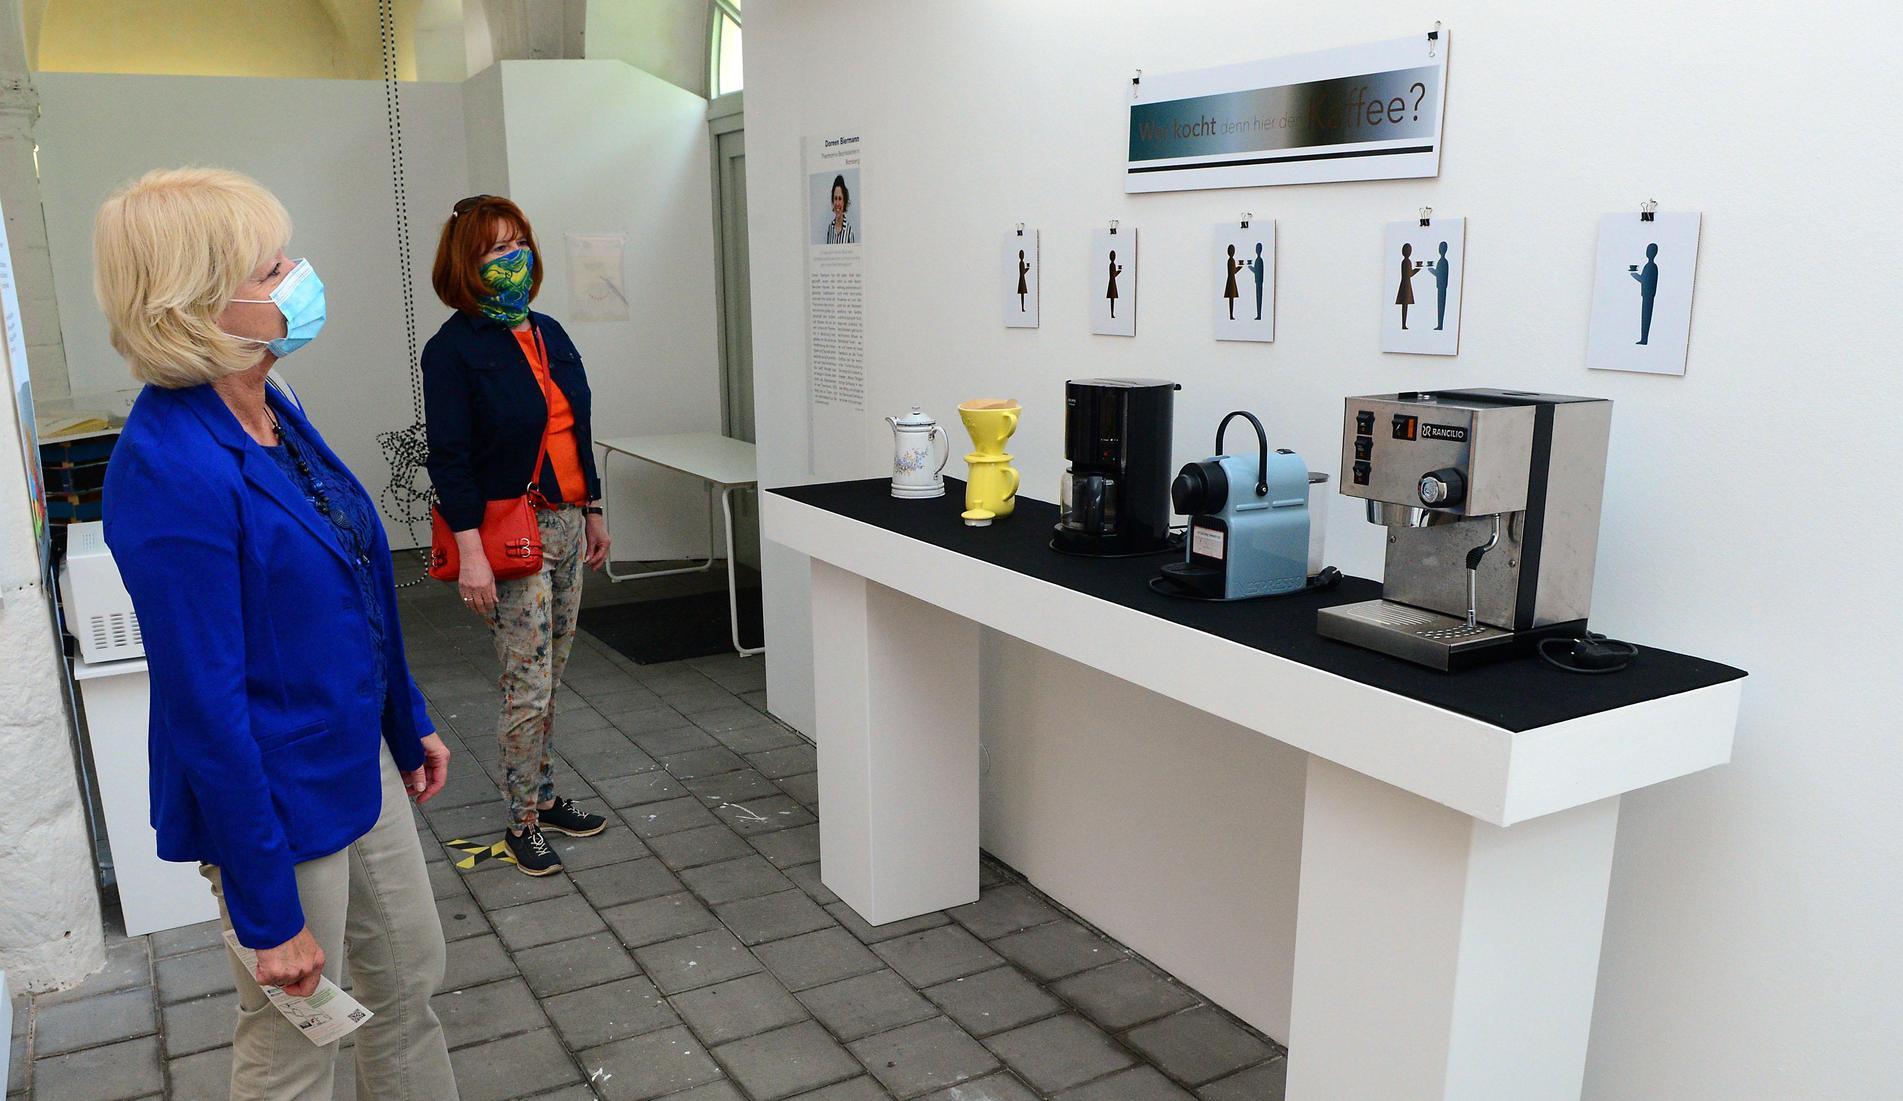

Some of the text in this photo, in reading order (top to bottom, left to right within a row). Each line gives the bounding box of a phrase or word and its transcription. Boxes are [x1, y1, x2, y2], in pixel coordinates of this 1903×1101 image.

[1173, 115, 1217, 139] kocht
[1220, 118, 1250, 134] denn
[1253, 115, 1276, 131] hier
[1432, 428, 1464, 439] RANCILIO
